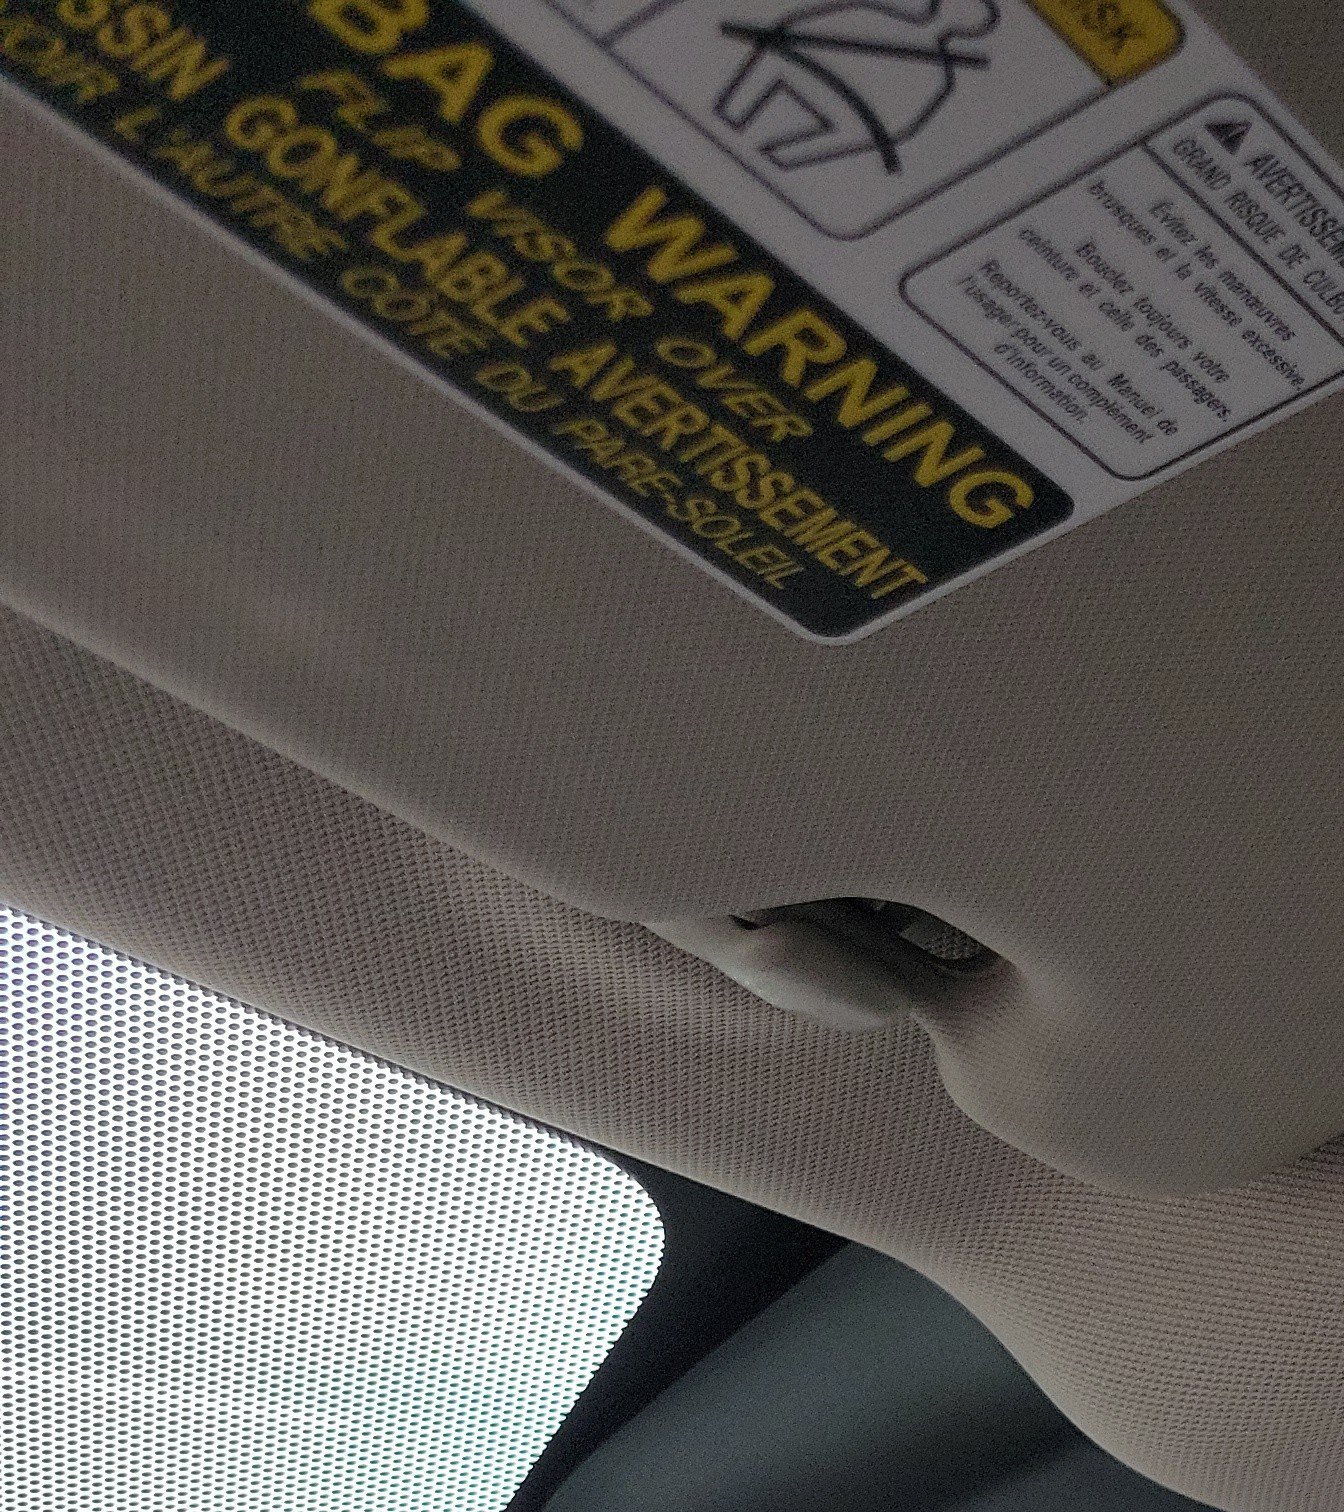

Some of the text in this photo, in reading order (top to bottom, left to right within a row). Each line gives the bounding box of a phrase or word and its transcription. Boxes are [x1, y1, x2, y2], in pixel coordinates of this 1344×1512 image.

[300, 70, 813, 442] FLIP VISOR OVER
[309, 0, 1033, 528] BAG WARNING
[1172, 138, 1236, 192] GRAND
[1224, 189, 1286, 245] RISQUE
[1276, 243, 1311, 269] DE
[1195, 244, 1219, 269] les
[30, 0, 927, 598] SSIN GONFLABLE AVERTISSEMENT
[978, 258, 1179, 436] Reportez-vous au Manuel de
[1009, 327, 1053, 356] pour
[1047, 356, 1072, 376] un
[1018, 228, 1080, 281] ceinture
[1078, 282, 1101, 298] et
[1098, 301, 1135, 332] celle
[1134, 333, 1164, 358] des
[1074, 240, 1230, 384] Bouclez toujours votre
[1155, 246, 1177, 262] et
[1193, 281, 1243, 327] vitesse
[475, 363, 562, 412] DU
[556, 418, 800, 589] PARE-SOLEIL
